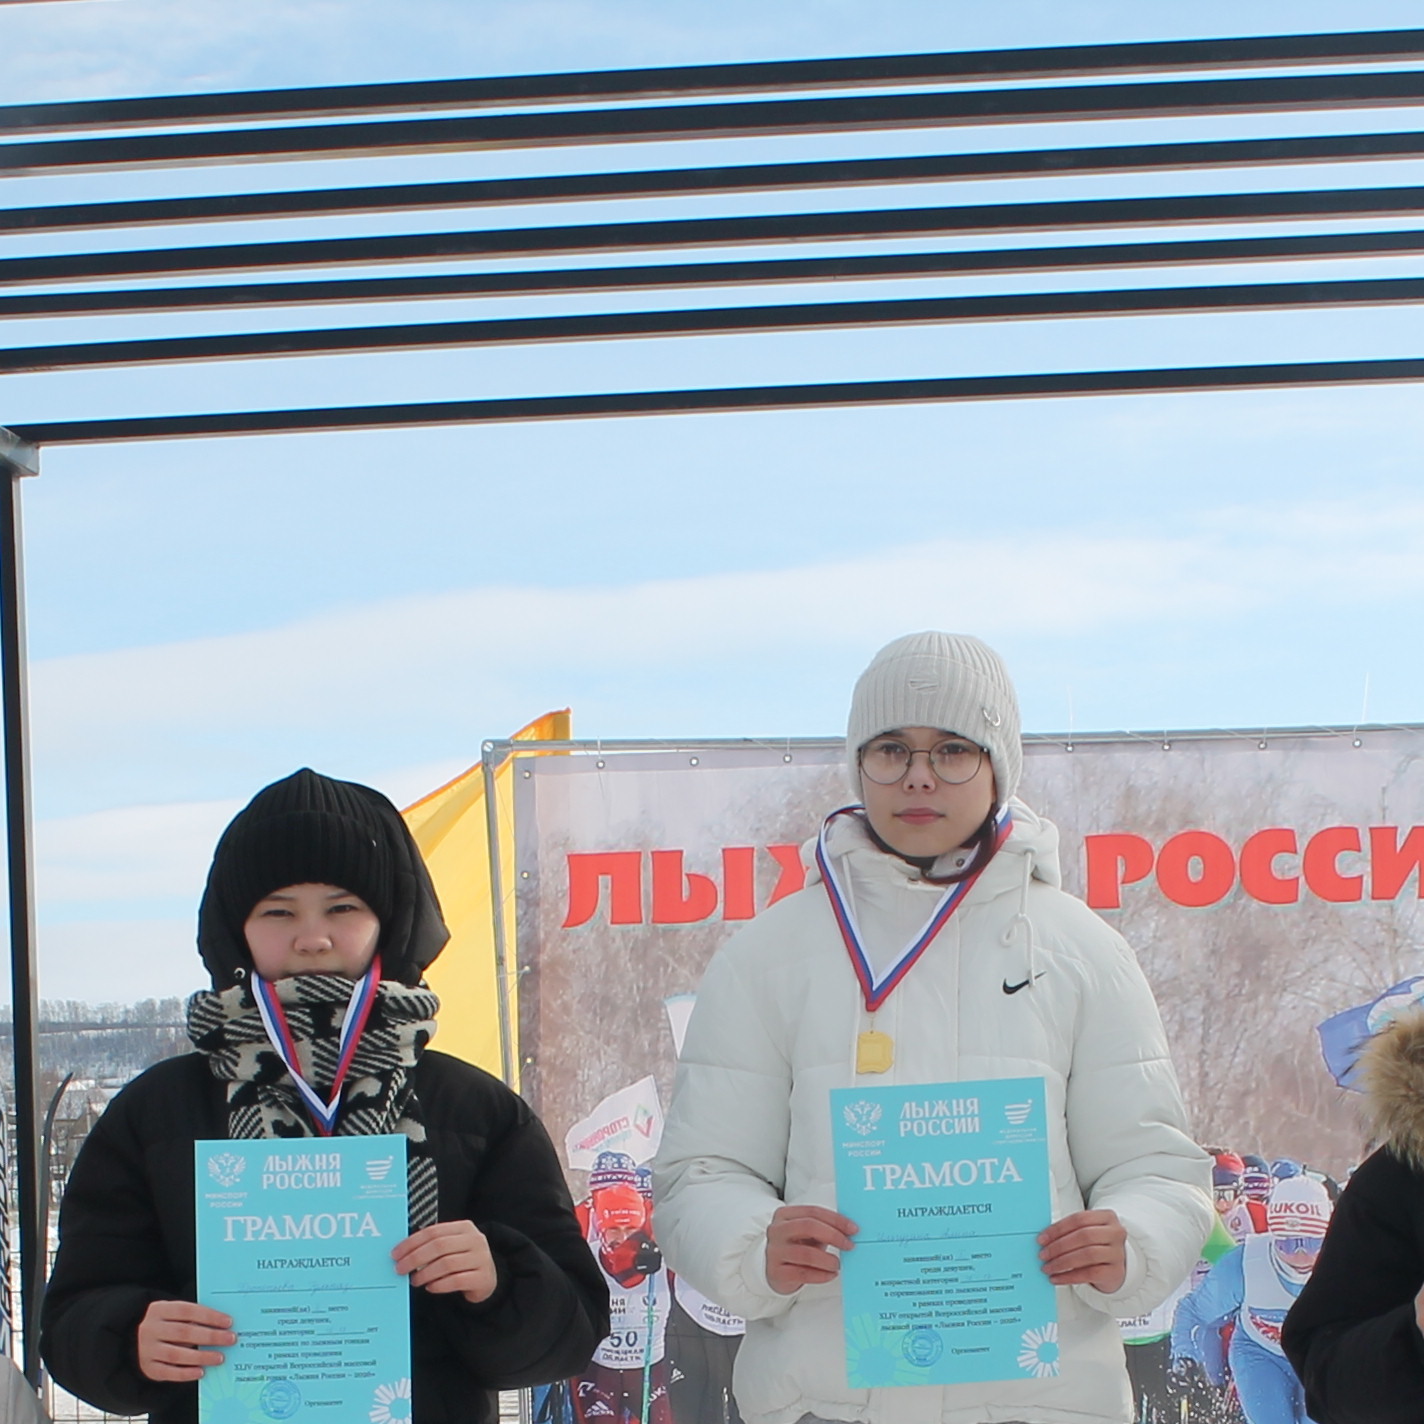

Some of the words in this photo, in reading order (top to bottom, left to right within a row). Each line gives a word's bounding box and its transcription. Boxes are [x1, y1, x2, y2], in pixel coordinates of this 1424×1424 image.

[899, 1097, 979, 1118] ЛЫЖНЯ
[899, 1116, 980, 1136] РОССИИ
[263, 1153, 341, 1171] ЛЫЖНЯ
[262, 1171, 341, 1189] РОССИИ
[861, 1156, 1023, 1190] ГРАМОТА
[897, 1203, 992, 1218] НАГРАЖДАЕТСЯ
[223, 1211, 381, 1241] ГРАМОТА
[256, 1257, 350, 1269] НАГРАЖДАЕТСЯ
[610, 1331, 638, 1348] 50
